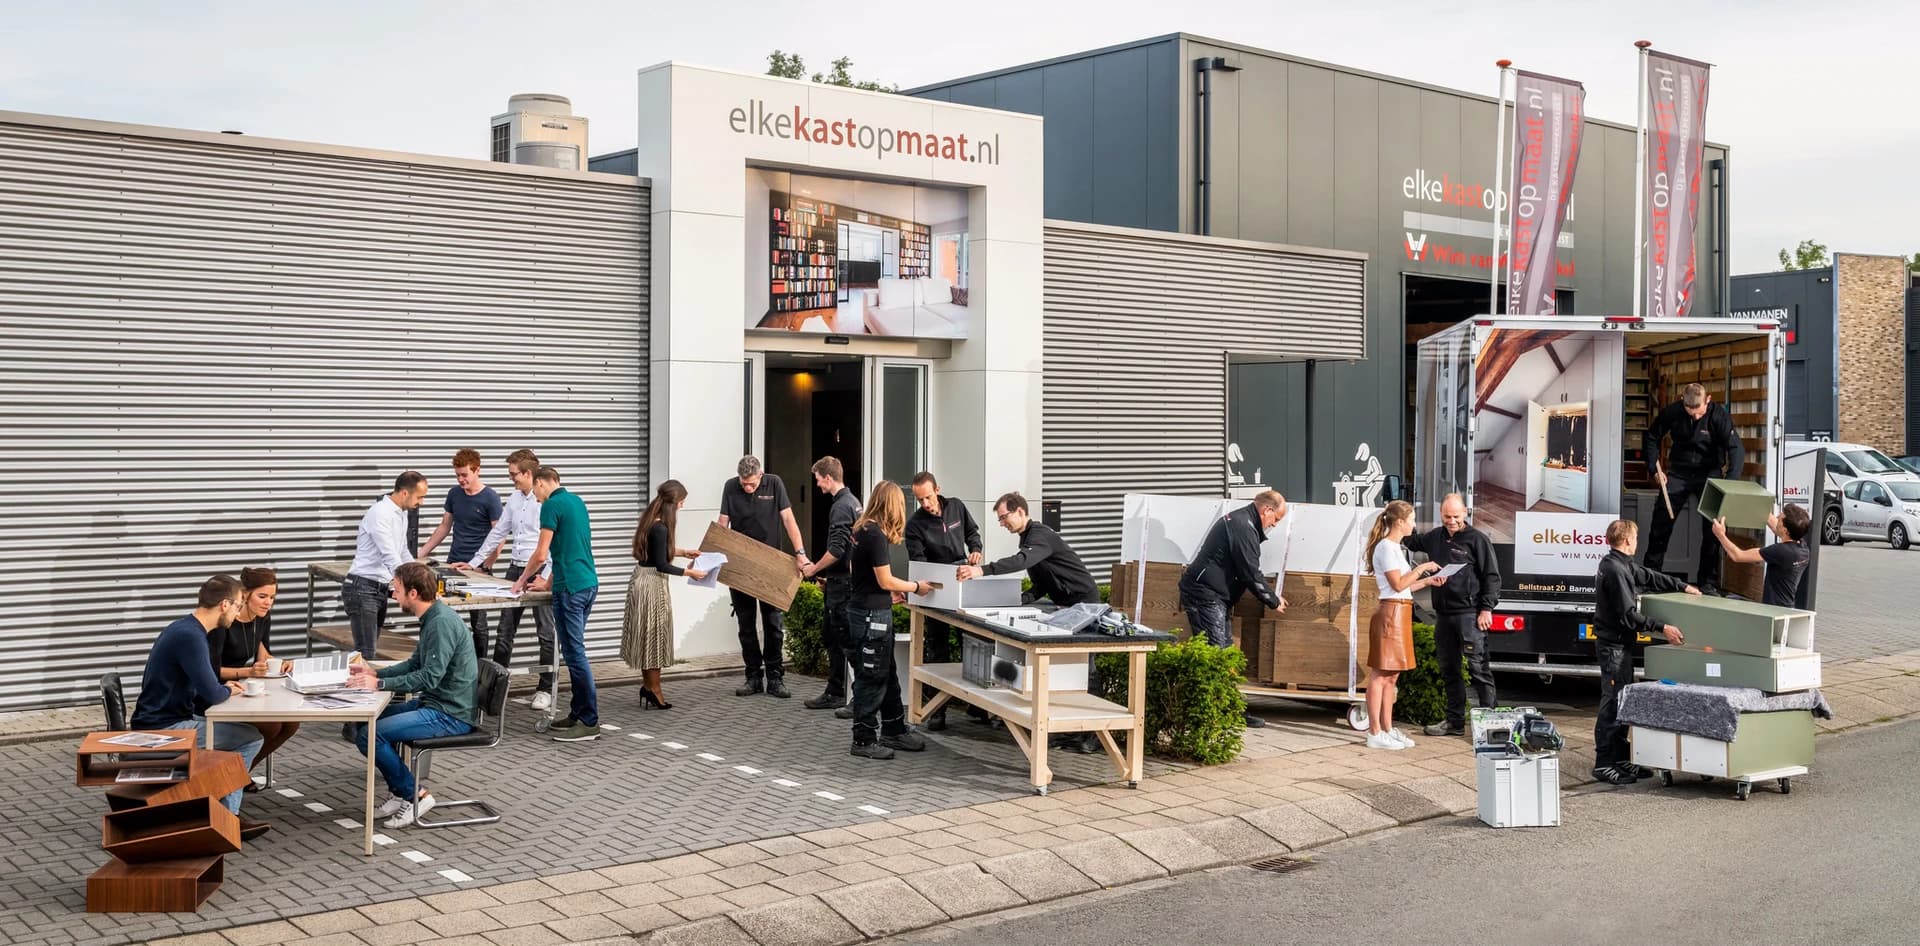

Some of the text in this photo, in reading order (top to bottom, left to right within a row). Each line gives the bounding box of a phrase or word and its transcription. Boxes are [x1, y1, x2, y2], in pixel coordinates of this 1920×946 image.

[729, 99, 999, 165] elkekastopmaat.nl
[1432, 244, 1466, 265] Wim
[1730, 307, 1788, 319] VAN MANEN
[1533, 528, 1610, 545] elkekast
[1519, 583, 1554, 591] Bellstraat
[1555, 584, 1566, 592] 20
